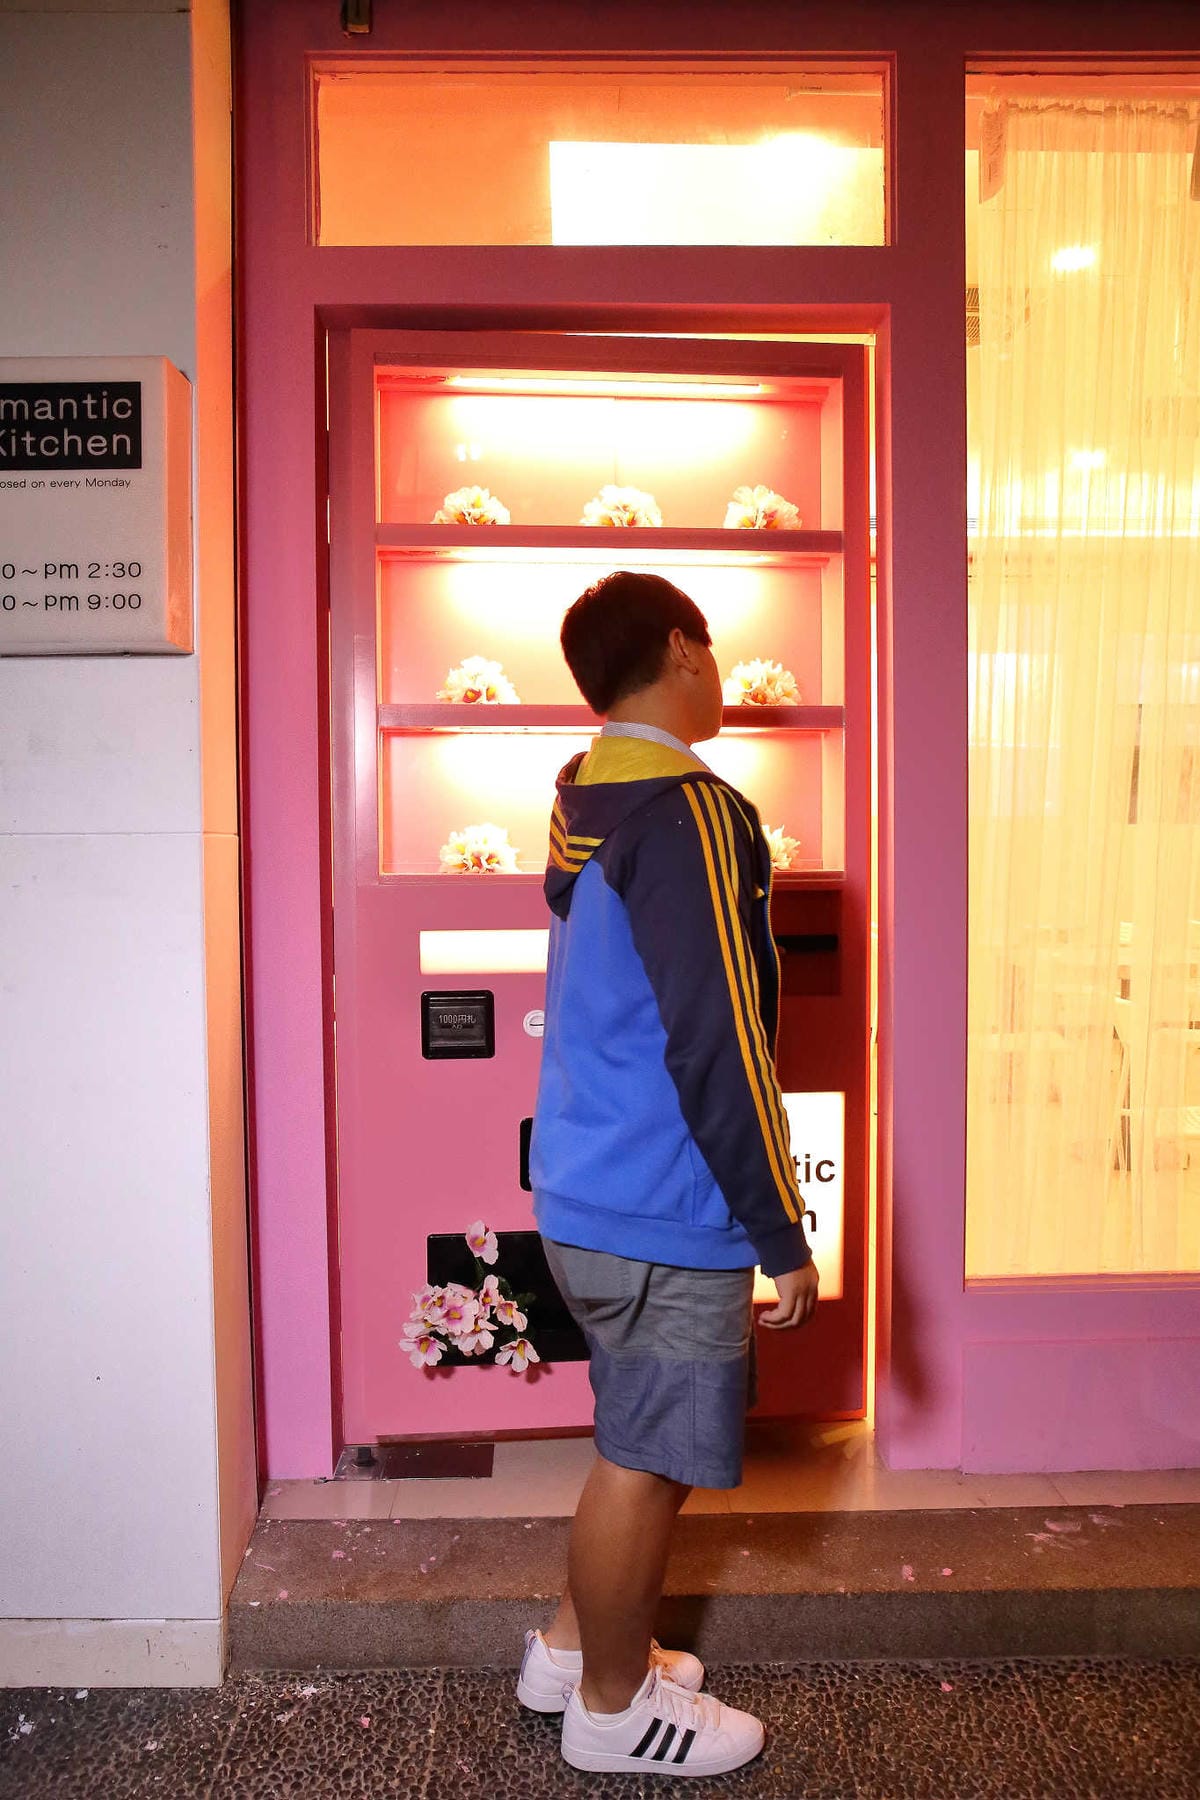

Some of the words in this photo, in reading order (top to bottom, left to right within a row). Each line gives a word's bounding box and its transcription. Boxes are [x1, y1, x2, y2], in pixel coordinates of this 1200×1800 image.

[31, 480, 46, 489] on
[50, 480, 81, 489] every
[85, 478, 132, 489] Monday
[44, 562, 79, 579] pm
[87, 561, 142, 579] 2:30
[44, 594, 79, 611] pm
[87, 593, 142, 610] 9:00
